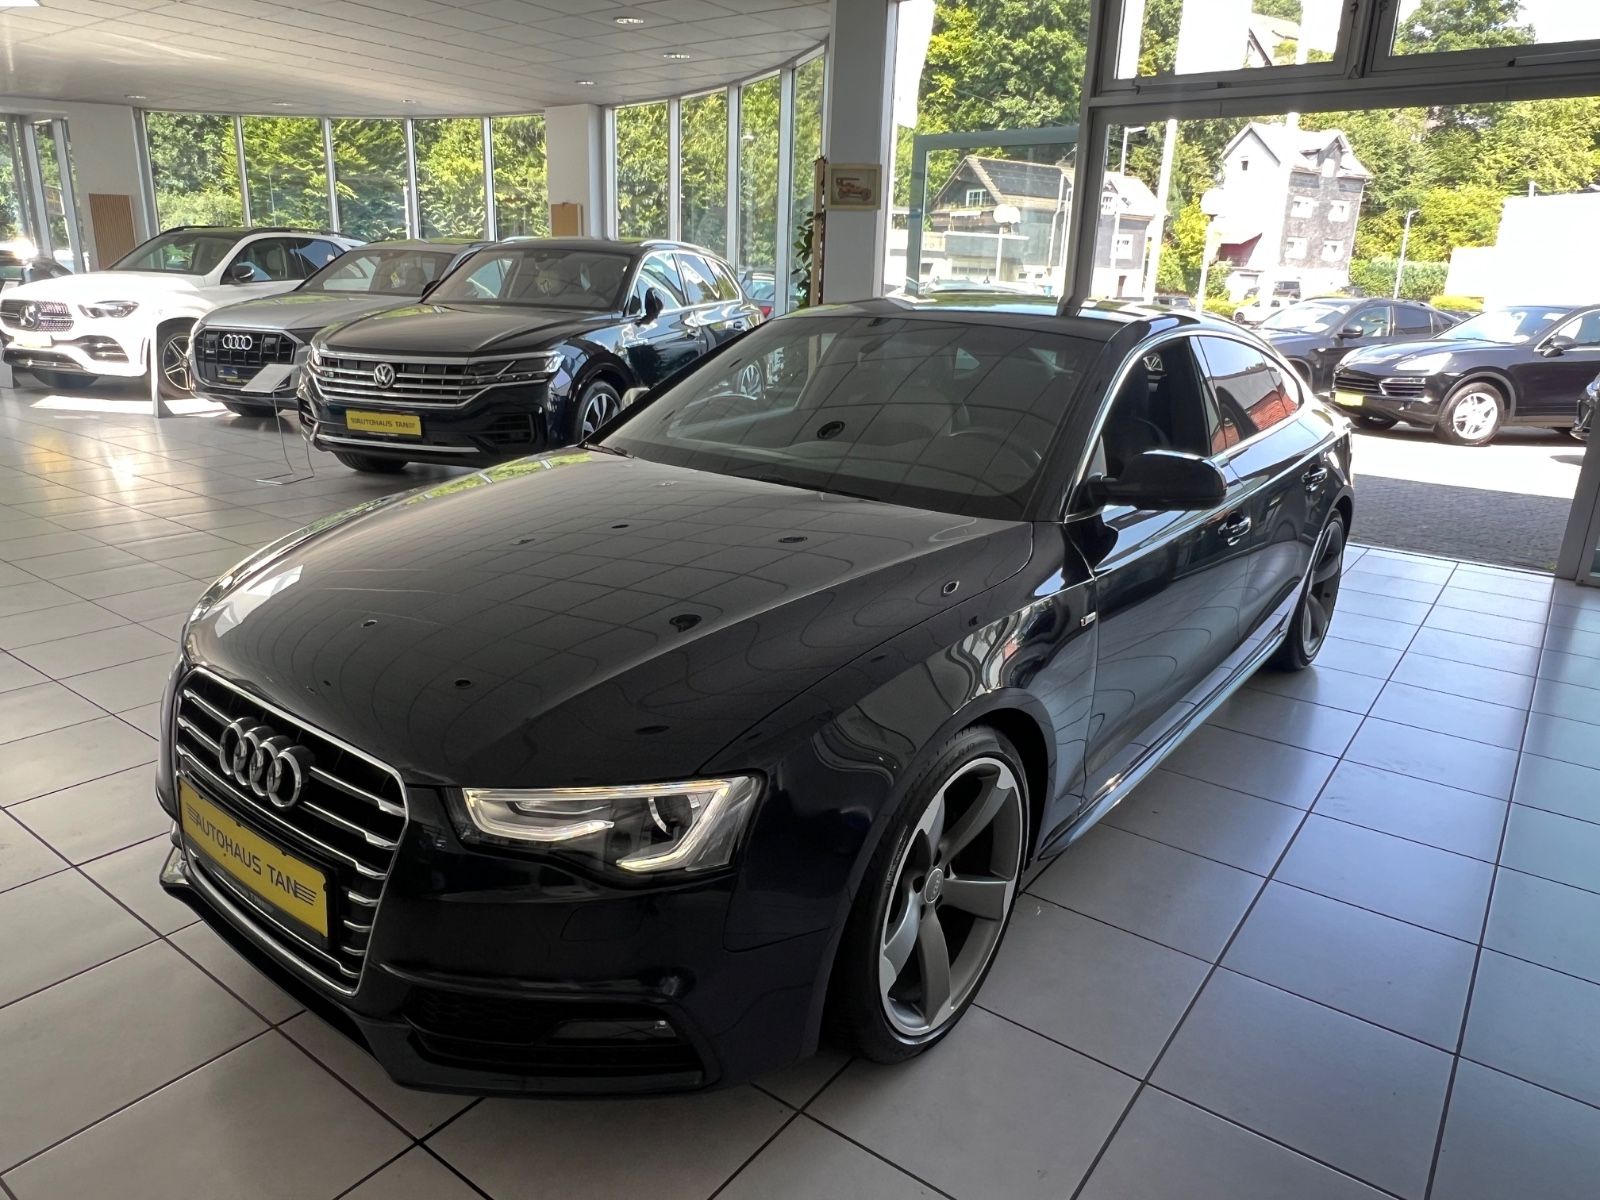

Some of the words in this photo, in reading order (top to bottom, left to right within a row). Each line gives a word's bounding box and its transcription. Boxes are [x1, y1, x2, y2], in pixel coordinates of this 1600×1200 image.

[356, 418, 392, 428] AUTOHAUS
[196, 813, 262, 875] AUTOHAUS
[266, 864, 298, 898] TAN
